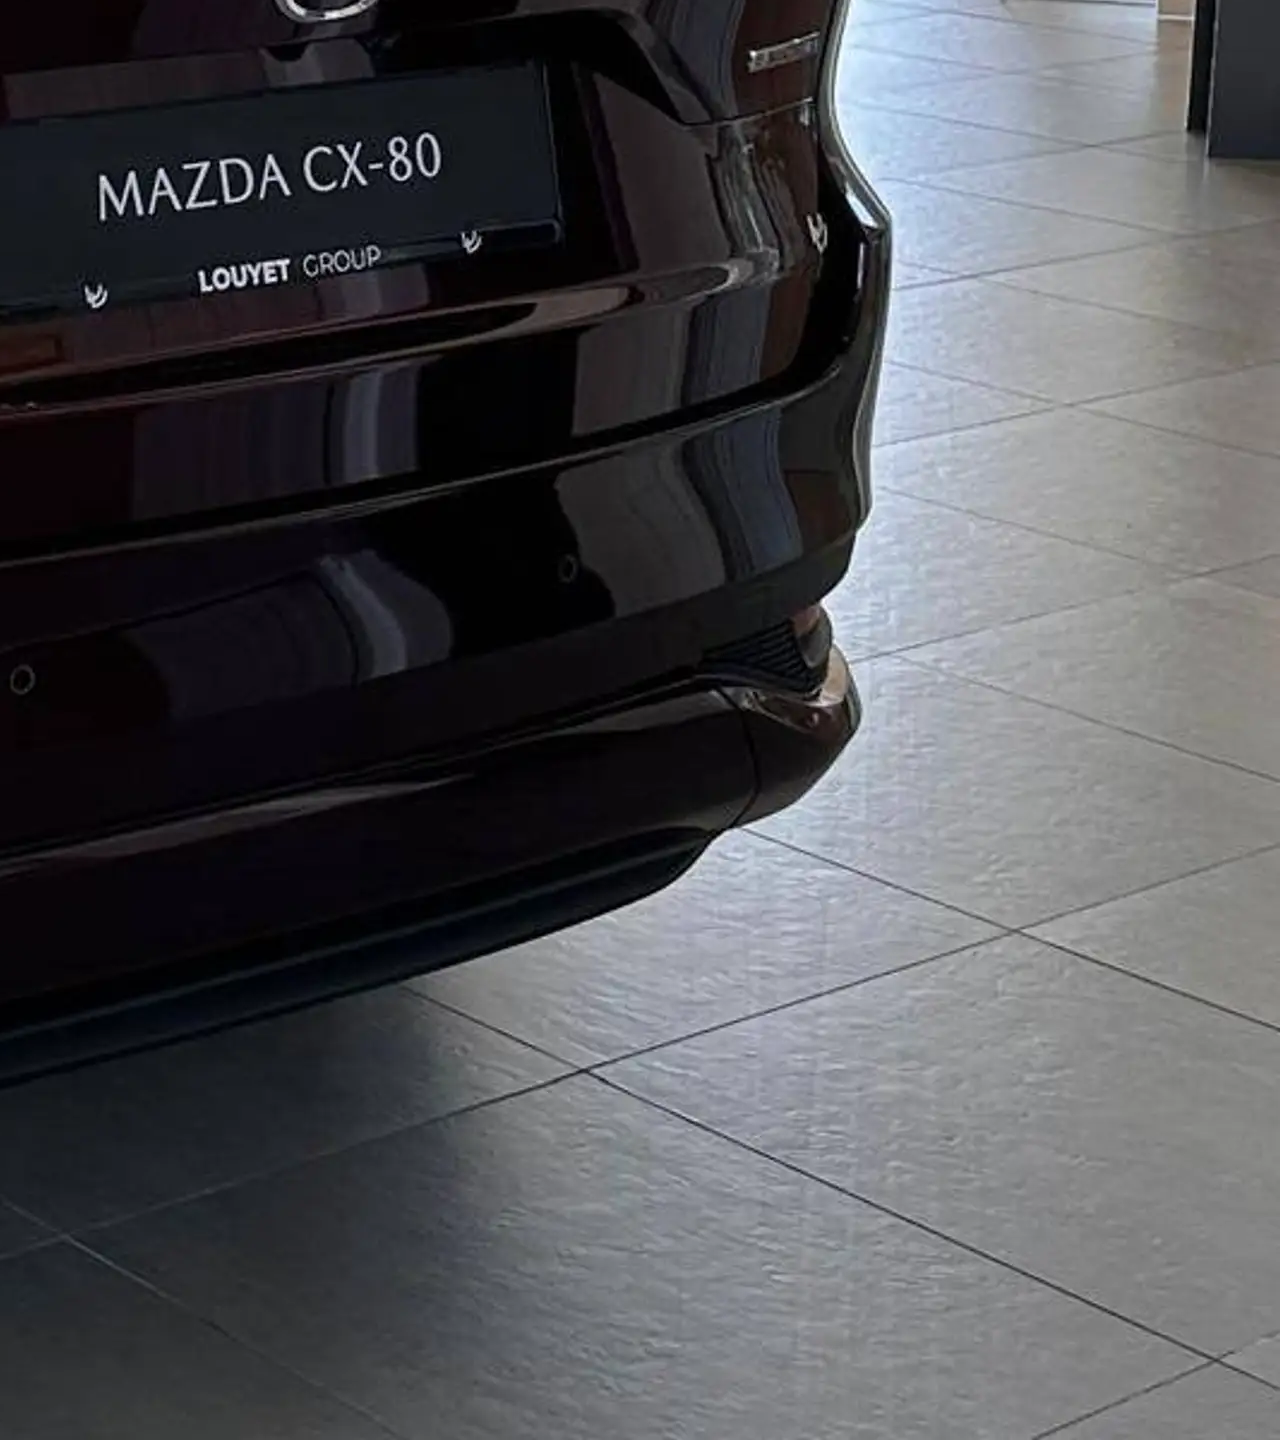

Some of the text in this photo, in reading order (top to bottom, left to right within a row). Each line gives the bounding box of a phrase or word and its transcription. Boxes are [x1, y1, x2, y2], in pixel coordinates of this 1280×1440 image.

[98, 132, 442, 222] MAZDA CX-80
[197, 244, 382, 293] LOUYET GROUP
